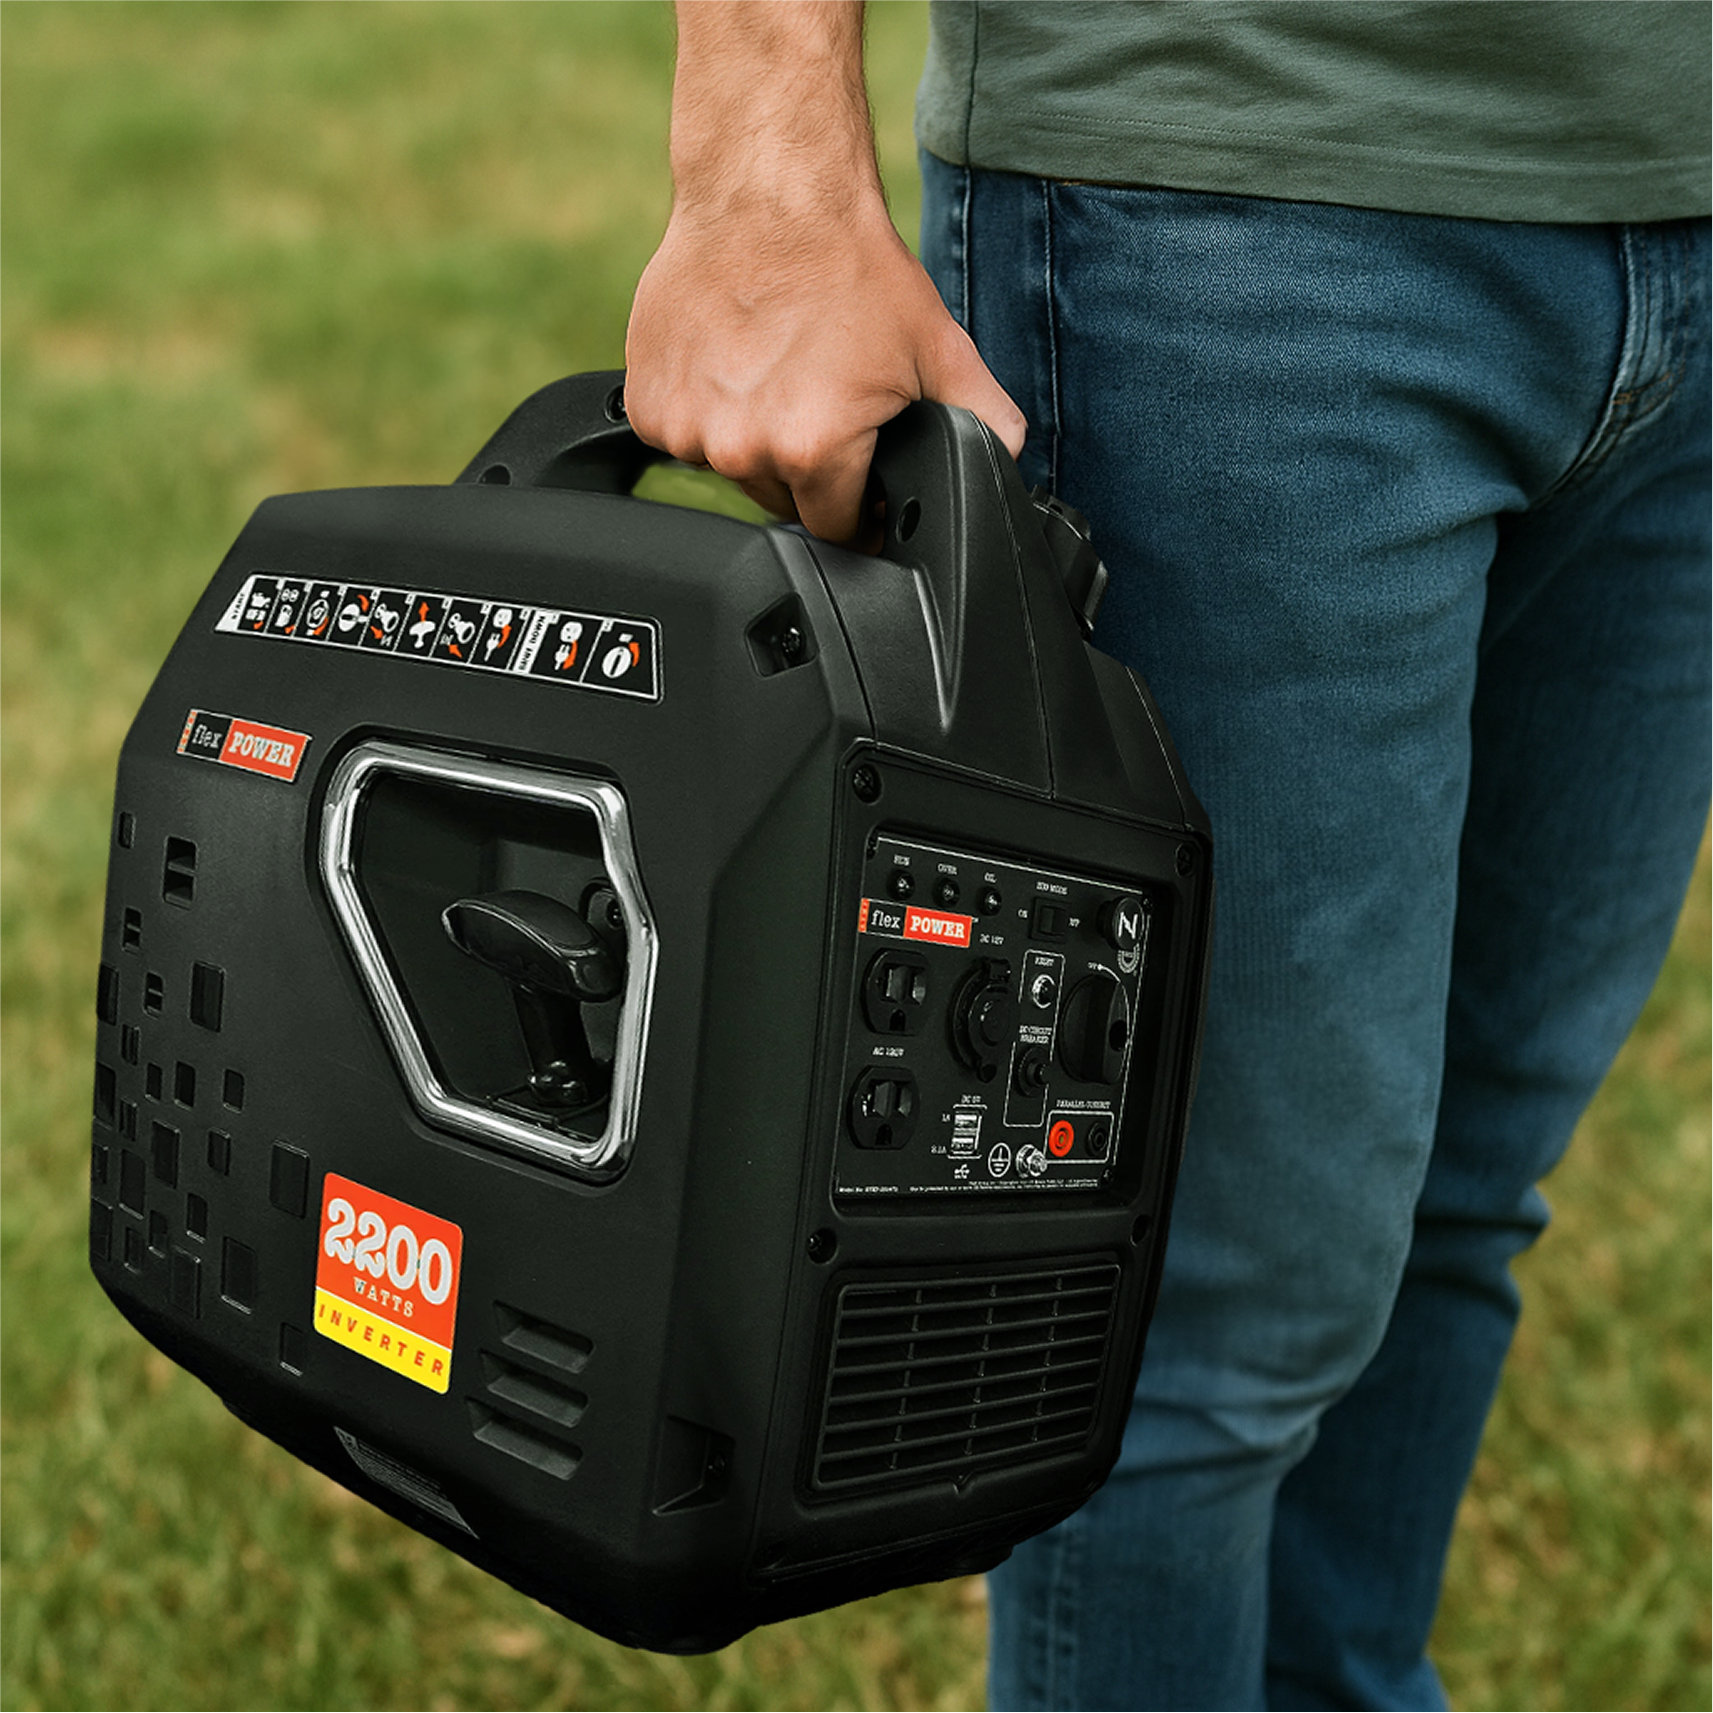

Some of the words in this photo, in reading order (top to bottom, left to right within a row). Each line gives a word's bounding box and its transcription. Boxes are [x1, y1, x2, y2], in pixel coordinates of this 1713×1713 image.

[529, 615, 546, 645] DOWN
[192, 723, 223, 749] flex
[228, 730, 296, 768] POWER
[870, 909, 902, 930] flex
[909, 914, 966, 940] POWER
[872, 1046, 885, 1056] AC
[323, 1197, 453, 1306] 2200
[352, 1275, 414, 1319] WATTS
[318, 1303, 445, 1378] INVERTER
